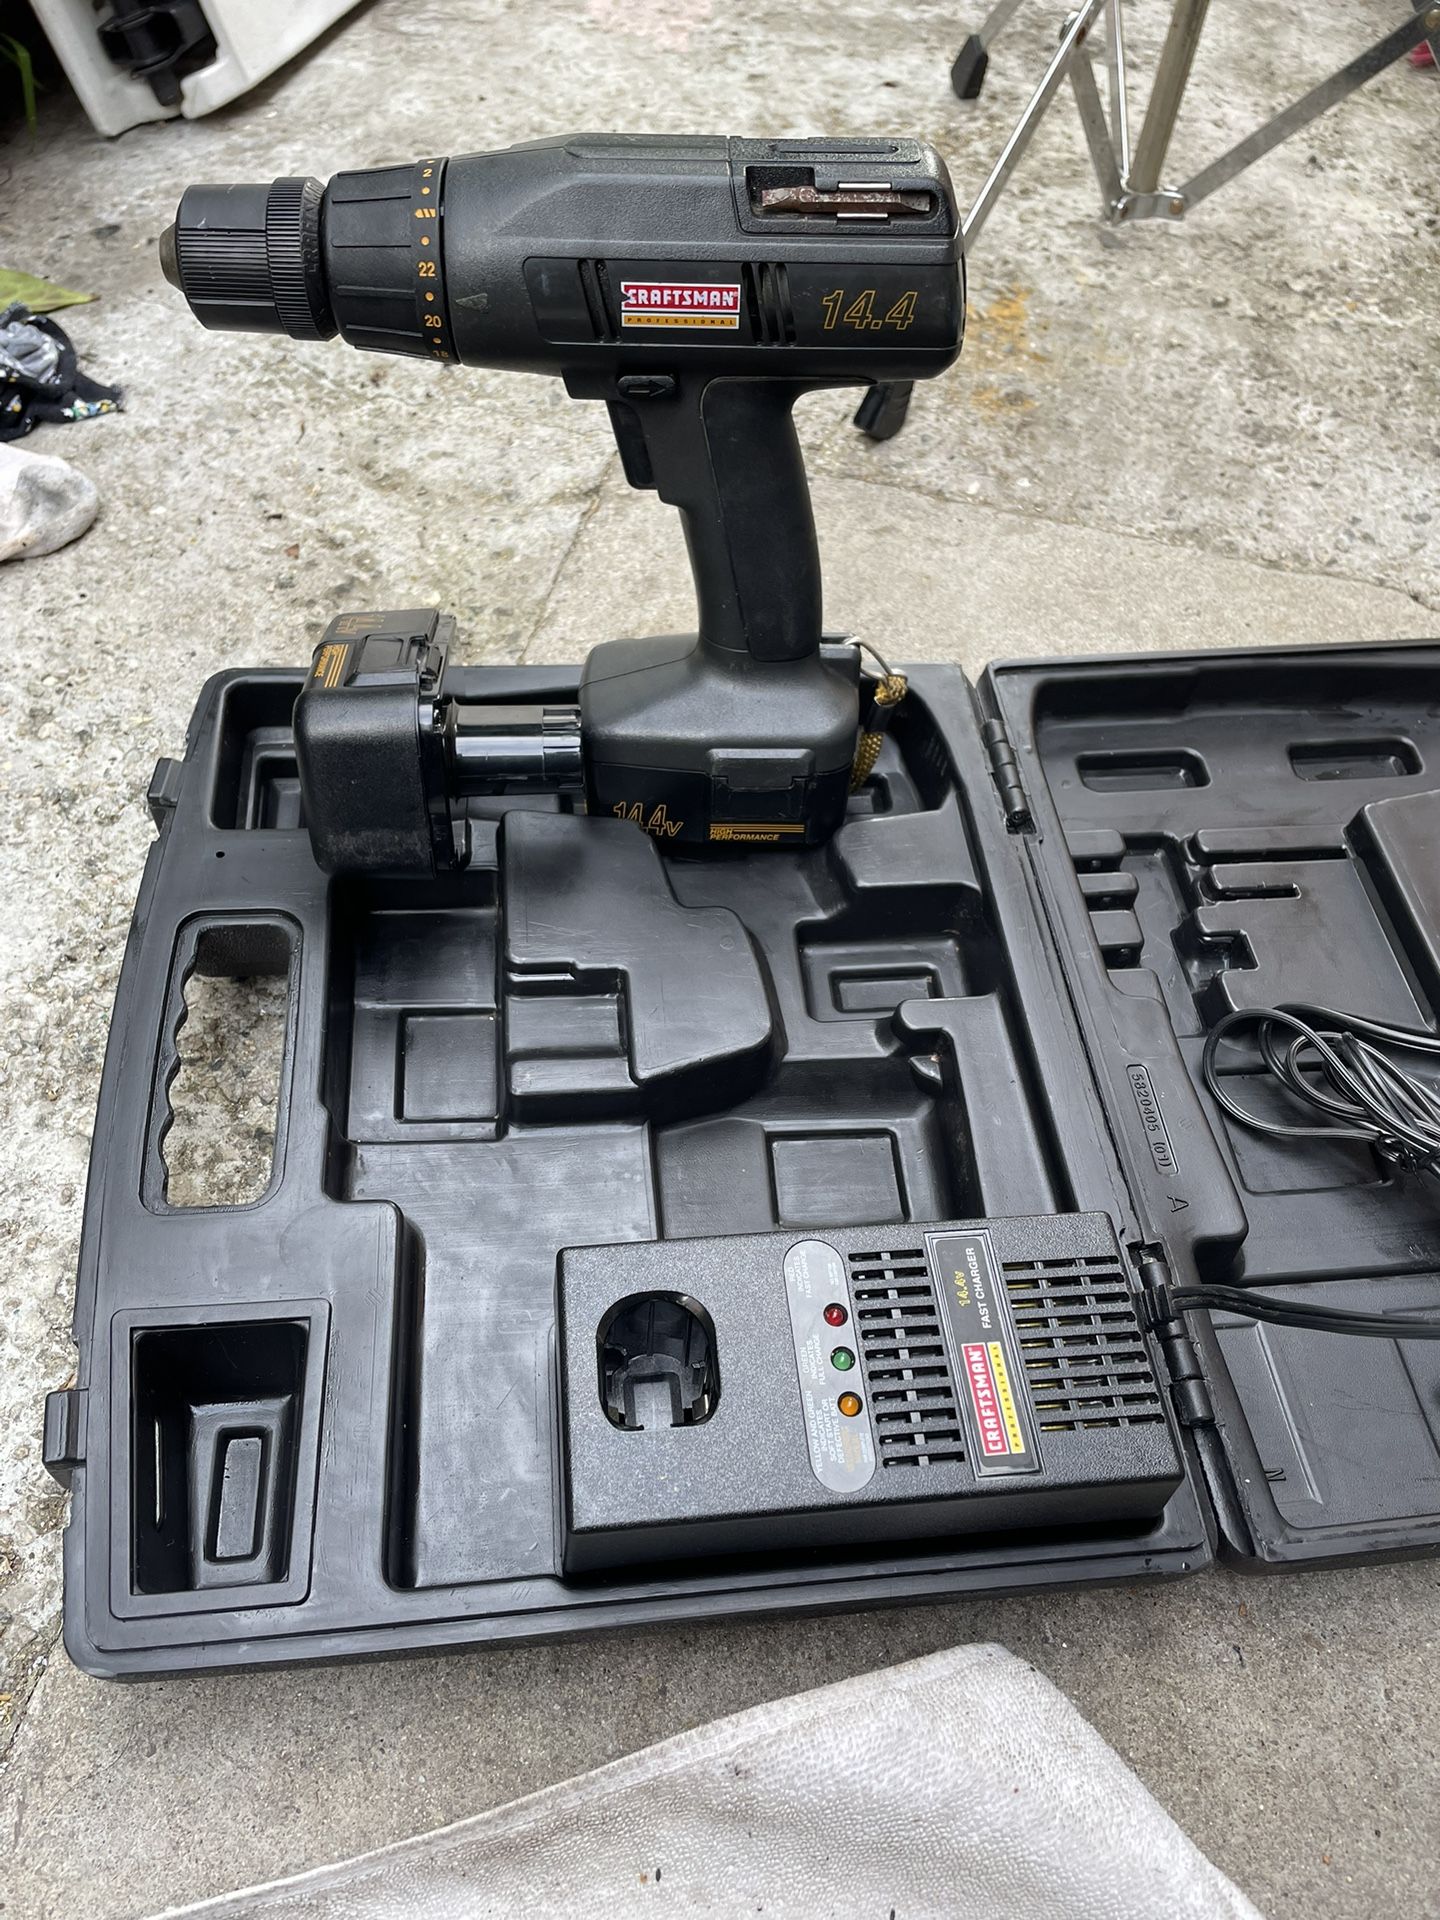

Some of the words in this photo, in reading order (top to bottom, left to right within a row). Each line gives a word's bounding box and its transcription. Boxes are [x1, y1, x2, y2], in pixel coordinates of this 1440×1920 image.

[422, 168, 433, 178] 2
[418, 261, 436, 277] 22
[626, 288, 735, 307] CRAFTSMAN
[822, 289, 918, 331] 14.4
[424, 314, 442, 328] 20
[627, 317, 733, 326] PROFESSIONAL
[709, 833, 780, 841] PERFORMANCE
[710, 827, 734, 835] HIGH
[793, 1255, 804, 1292] INDICATES
[965, 1246, 986, 1300] CHARGER
[804, 1279, 813, 1298] FAST
[977, 1301, 993, 1330] FAST
[800, 1346, 810, 1374] GREEN
[806, 1339, 818, 1380] INDICATES
[812, 1334, 823, 1365] CHARGE
[818, 1366, 826, 1385] FULL
[805, 1390, 815, 1419] GREEN
[821, 1398, 829, 1411] OR
[969, 1349, 1004, 1452] CRAFTSMAN
[810, 1419, 818, 1437] AND
[815, 1409, 828, 1451] INDICATES
[823, 1412, 834, 1439] START
[827, 1439, 837, 1462] SOFT
[832, 1418, 846, 1464] DEFECTIVE
[812, 1438, 823, 1473] YELLOW
